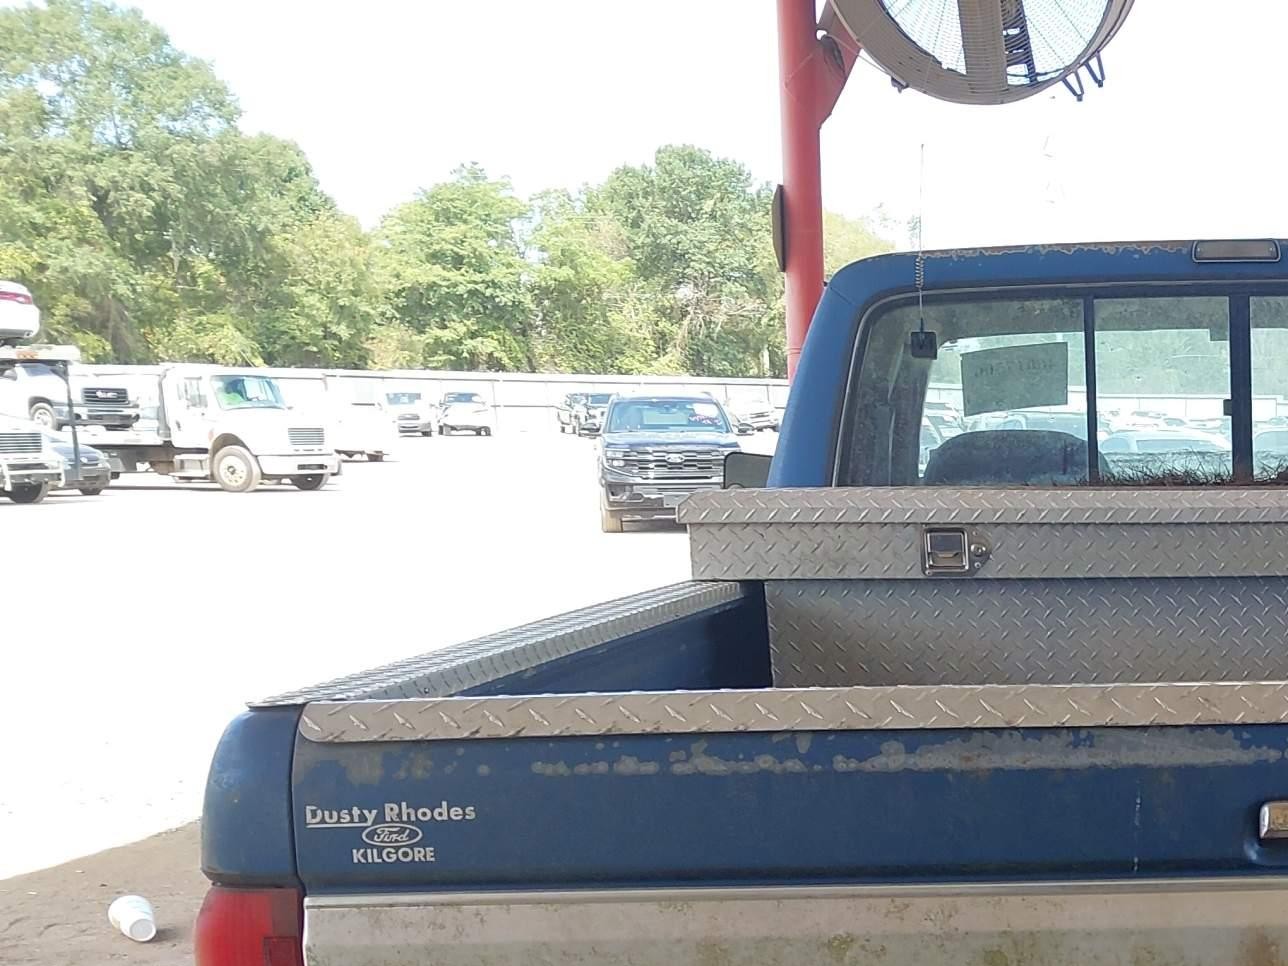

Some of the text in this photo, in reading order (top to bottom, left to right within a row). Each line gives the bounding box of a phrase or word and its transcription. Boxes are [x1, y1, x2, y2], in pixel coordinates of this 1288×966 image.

[304, 801, 476, 827] Dusty Rhodes
[372, 826, 411, 842] Ford
[352, 847, 436, 864] KILGORE
